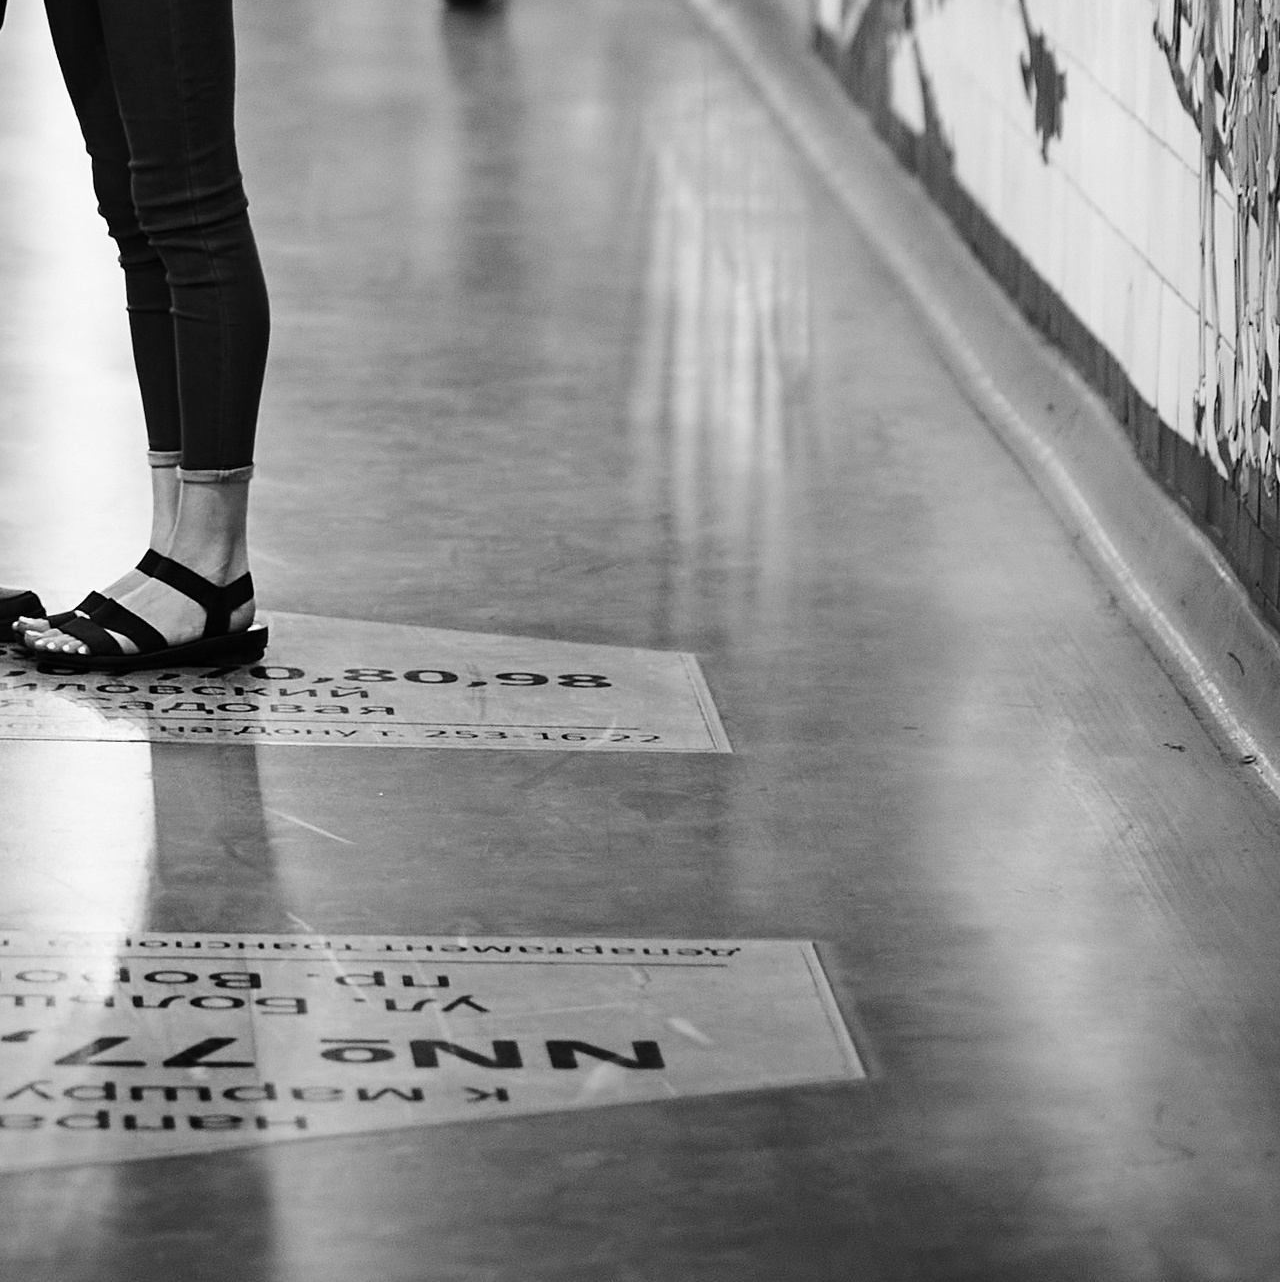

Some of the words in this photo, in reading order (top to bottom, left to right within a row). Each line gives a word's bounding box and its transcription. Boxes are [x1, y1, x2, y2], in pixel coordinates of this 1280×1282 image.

[424, 729, 665, 745] 253-16-22
[47, 937, 356, 953] транспо
[375, 942, 741, 958] департамент
[305, 969, 451, 989] пр.
[354, 994, 491, 1015] ул.
